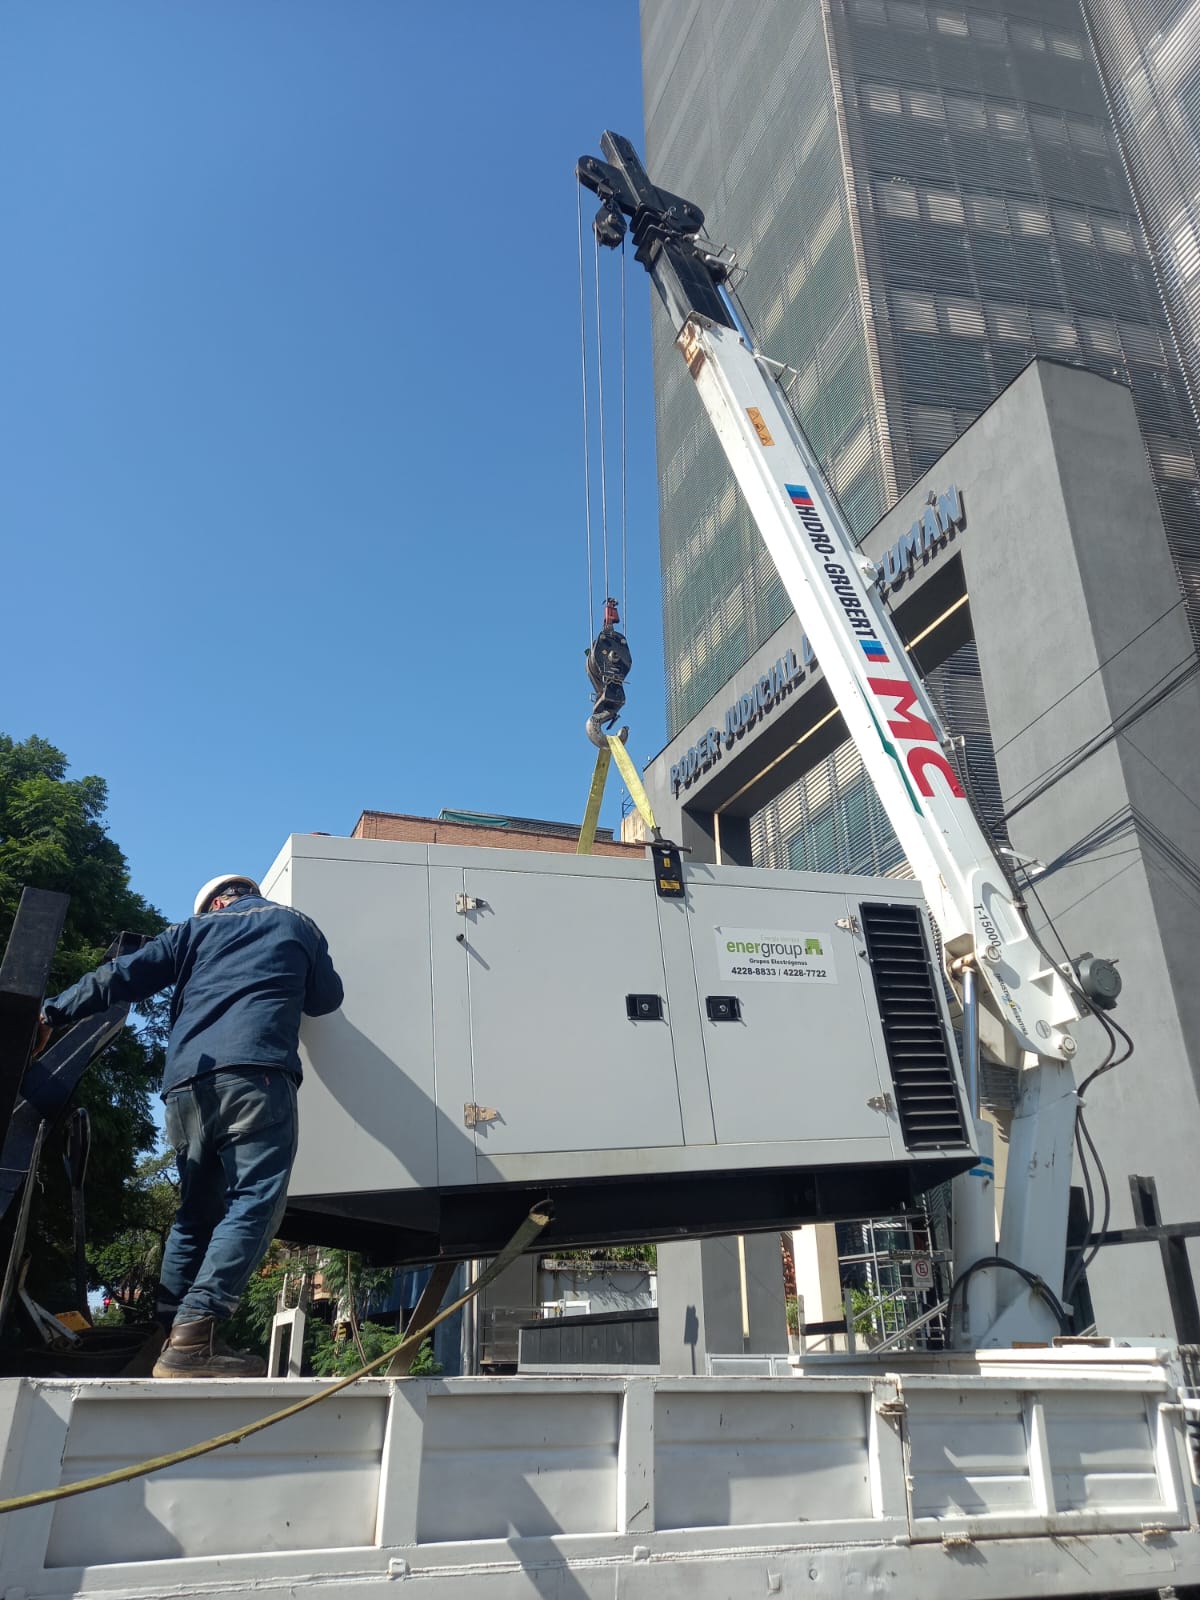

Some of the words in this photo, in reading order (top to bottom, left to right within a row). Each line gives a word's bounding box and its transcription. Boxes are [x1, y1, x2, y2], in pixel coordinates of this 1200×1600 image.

[795, 504, 878, 640] HIDRO-GRUBERT
[670, 726, 718, 794] PODER
[719, 648, 800, 744] JUDICIAL
[866, 676, 966, 799] MC
[726, 940, 802, 958] energroup
[973, 903, 1001, 948] T-15000
[731, 966, 777, 976] 4228-8833
[783, 968, 827, 978] 4228-7722
